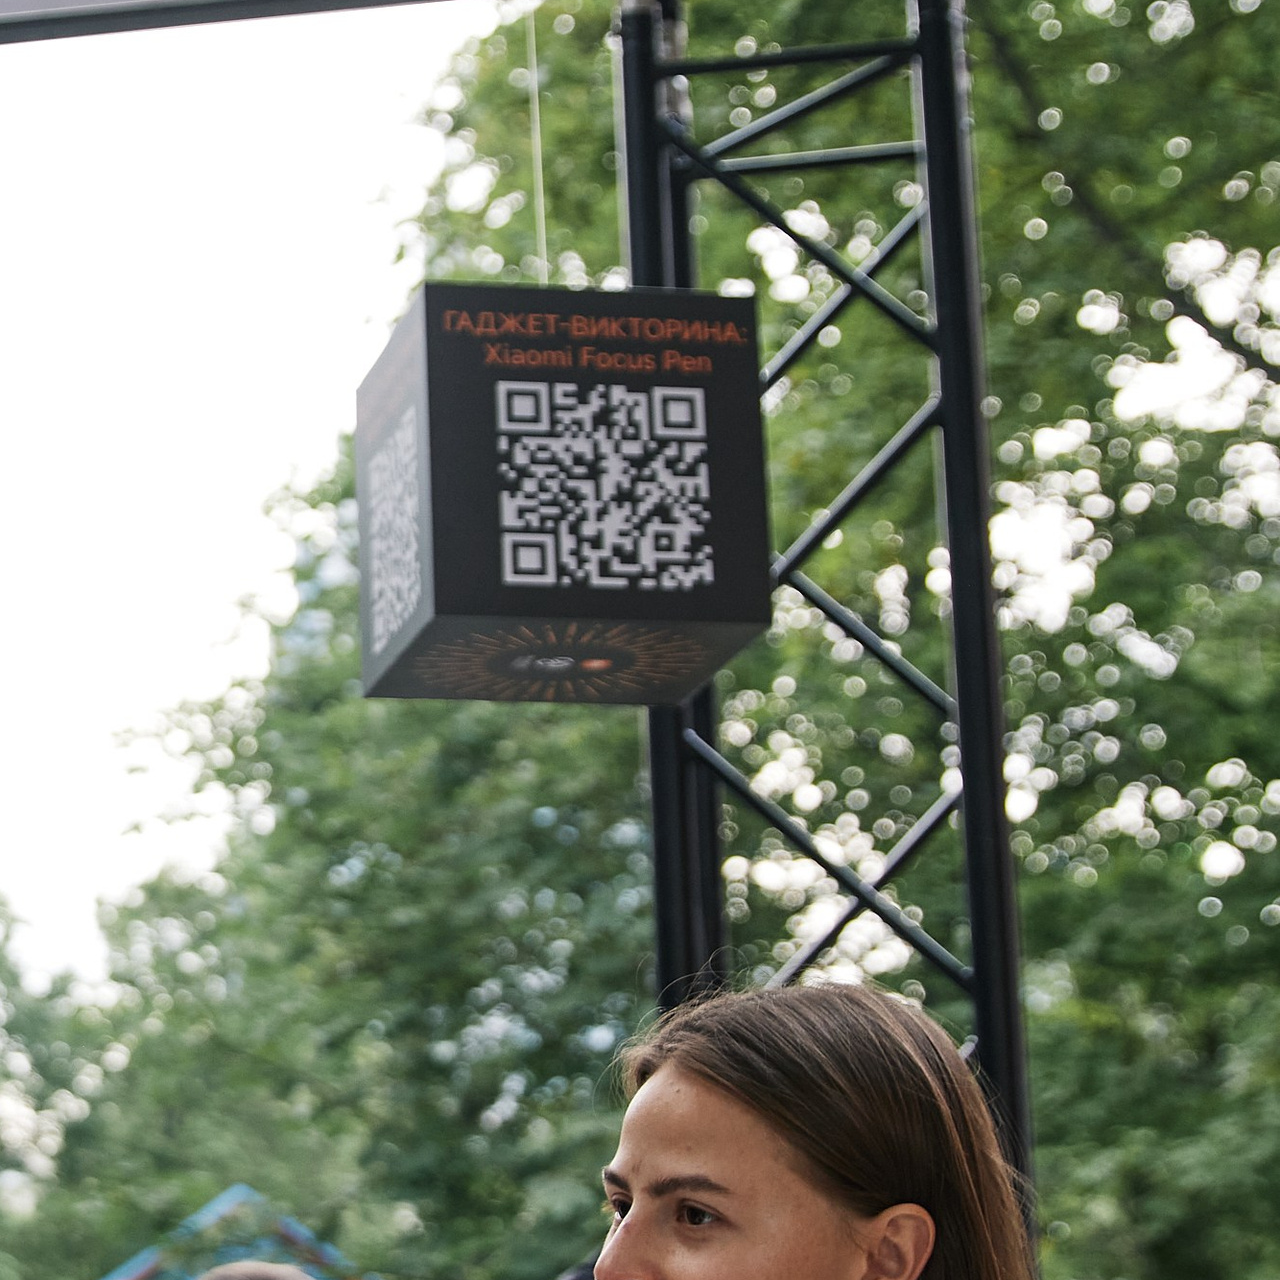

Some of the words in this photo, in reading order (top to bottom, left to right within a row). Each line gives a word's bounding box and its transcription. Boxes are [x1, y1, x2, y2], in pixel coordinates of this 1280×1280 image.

[443, 309, 747, 344] ГАДЖЕТ-ВИКТОРИНА:
[485, 343, 573, 368] Xiaomi
[580, 346, 656, 372] Focus
[663, 349, 713, 374] Pen
